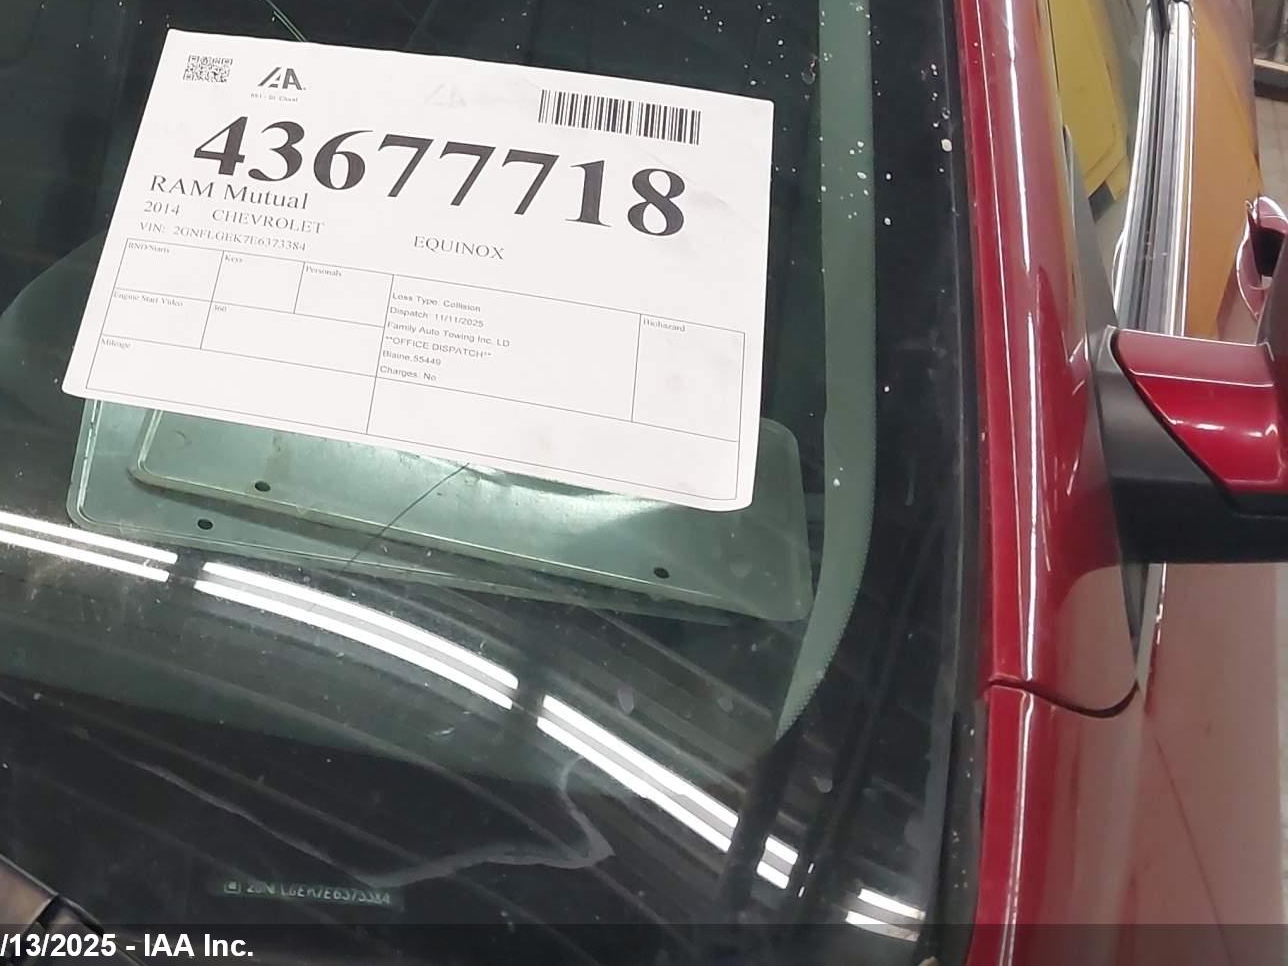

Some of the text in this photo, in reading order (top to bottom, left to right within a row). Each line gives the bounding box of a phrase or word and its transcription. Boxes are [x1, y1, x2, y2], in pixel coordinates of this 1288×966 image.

[193, 116, 686, 237] 43677718
[150, 174, 310, 210] RAM Mutual
[138, 221, 166, 235] VIN:
[143, 200, 505, 260] 2014 CHEVROLET EQUINOX
[392, 292, 413, 302] Loss
[443, 299, 481, 313] Collision
[435, 313, 484, 328] 11/11/2025
[387, 321, 417, 334] Family
[418, 326, 441, 337] Auto
[443, 329, 475, 343] Towing
[496, 338, 510, 348] LD
[423, 371, 437, 382] No
